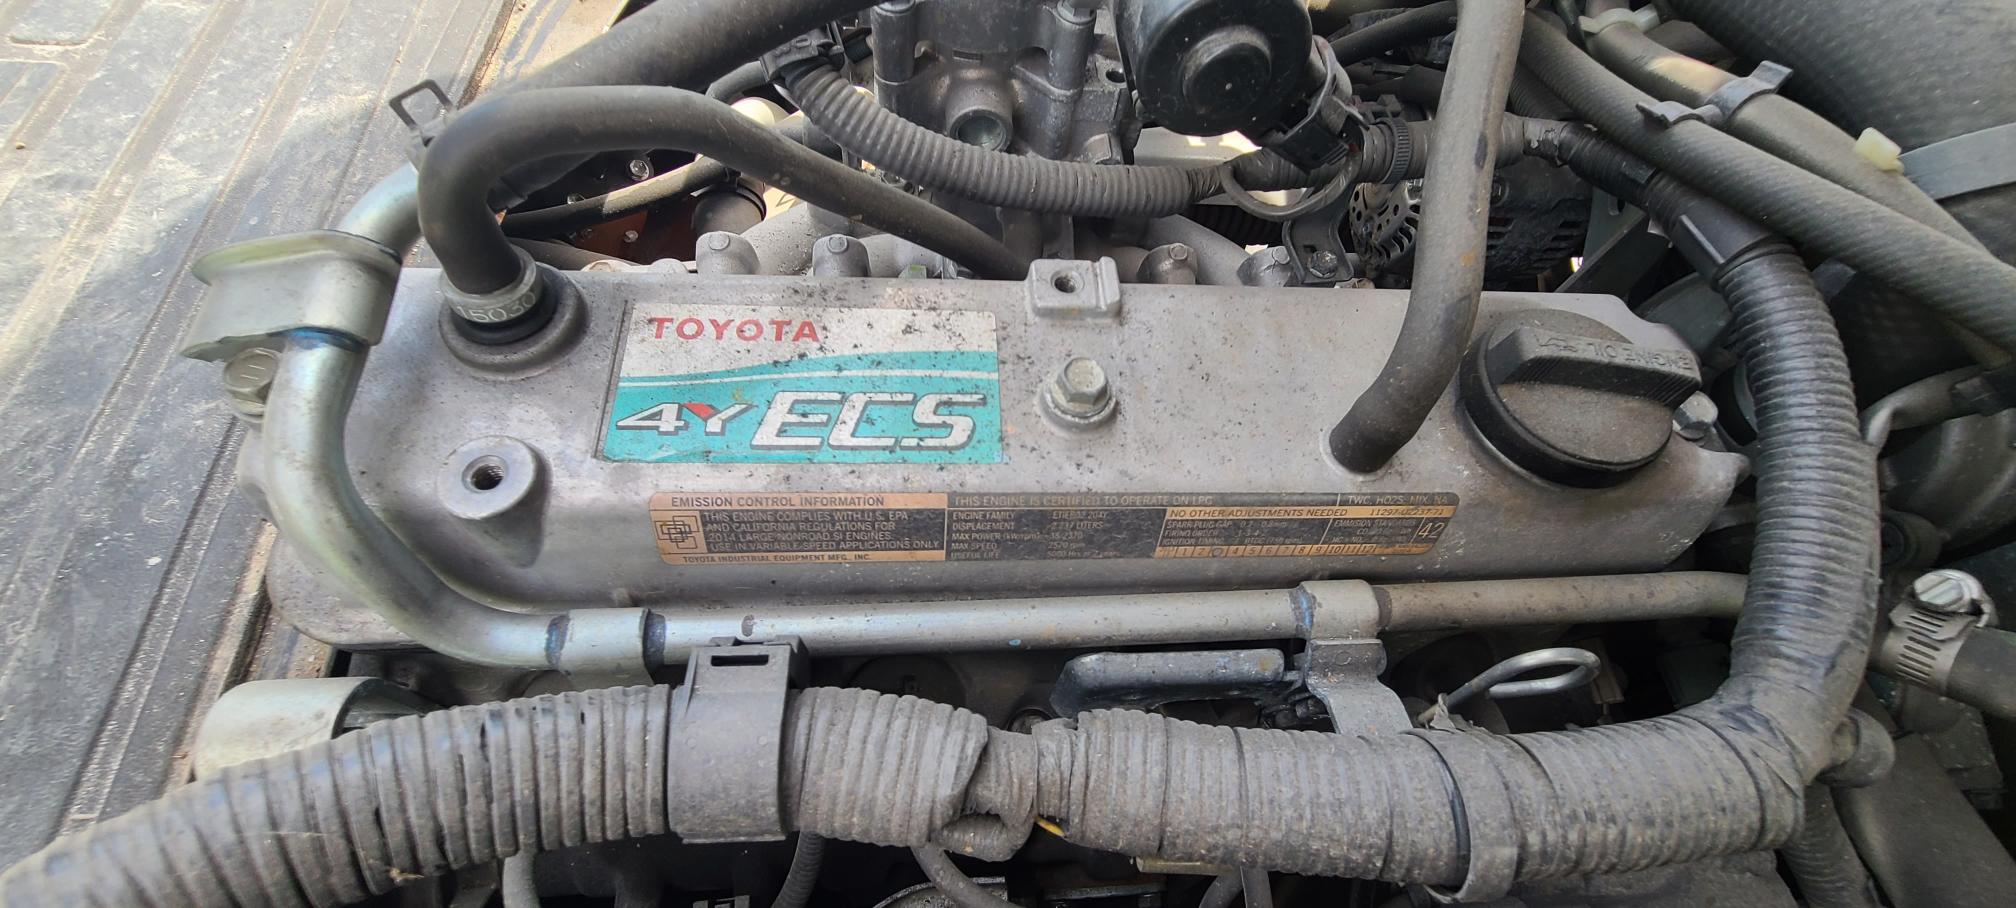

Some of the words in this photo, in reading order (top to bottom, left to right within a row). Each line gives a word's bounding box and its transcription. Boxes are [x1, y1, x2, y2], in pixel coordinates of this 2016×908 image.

[456, 291, 536, 323] 15030
[650, 317, 820, 343] TOYOTA
[615, 401, 758, 437] 4Y
[750, 390, 988, 451] ECS
[671, 497, 733, 507] EMISSION
[737, 497, 796, 507] CONTROL
[800, 497, 885, 507] INFORMATION
[955, 496, 981, 506] THIS
[983, 496, 1026, 506] ENGINE
[1030, 496, 1040, 506] IS
[1044, 496, 1101, 506] CERTIFIED
[1104, 496, 1118, 506] TO
[1121, 496, 1170, 506] OPERATE
[1173, 496, 1189, 506] ON
[1192, 496, 1213, 506] LPG
[703, 511, 729, 521] THIS
[733, 511, 775, 521] ENGINE
[777, 511, 830, 521] COMPLIES
[834, 511, 861, 521] WITH
[888, 511, 909, 521] EPA
[952, 511, 984, 520] ENGINE
[986, 511, 1016, 520] FAMILY
[1170, 508, 1185, 517] NO
[1189, 508, 1226, 517] OTHER
[1228, 508, 1304, 517] ADJUSTMENTS
[1306, 508, 1348, 517] NEEDED
[705, 522, 731, 531] AND
[734, 522, 796, 531] CALIFORNIA
[799, 522, 872, 531] REGULATIONS
[875, 522, 896, 531] FOR
[952, 521, 1015, 530] DISPLACEMENT
[1076, 521, 1104, 529] LITERS
[1194, 520, 1215, 528] PLUG
[1216, 520, 1233, 528] GAP
[1164, 529, 1191, 537] FIRING
[1192, 529, 1218, 537] ORDER
[1417, 522, 1446, 539] 42
[707, 532, 735, 541] 2014
[740, 532, 774, 541] LARGE
[776, 532, 830, 541] NONROAD
[834, 532, 843, 541] SI
[952, 533, 970, 541] MAX
[972, 533, 1000, 541] POWER
[1162, 537, 1197, 545] IGNITION
[711, 543, 733, 551] USE
[736, 542, 747, 551] IN
[840, 541, 911, 550] APPLICATIONS
[951, 543, 970, 551] MAX
[972, 543, 998, 551] SPEED
[1298, 546, 1306, 554] 8
[1315, 546, 1323, 554] 9
[1345, 545, 1355, 553] 11
[1361, 545, 1373, 553] 12
[951, 551, 981, 559] USEFUL
[984, 551, 1000, 559] LIFE
